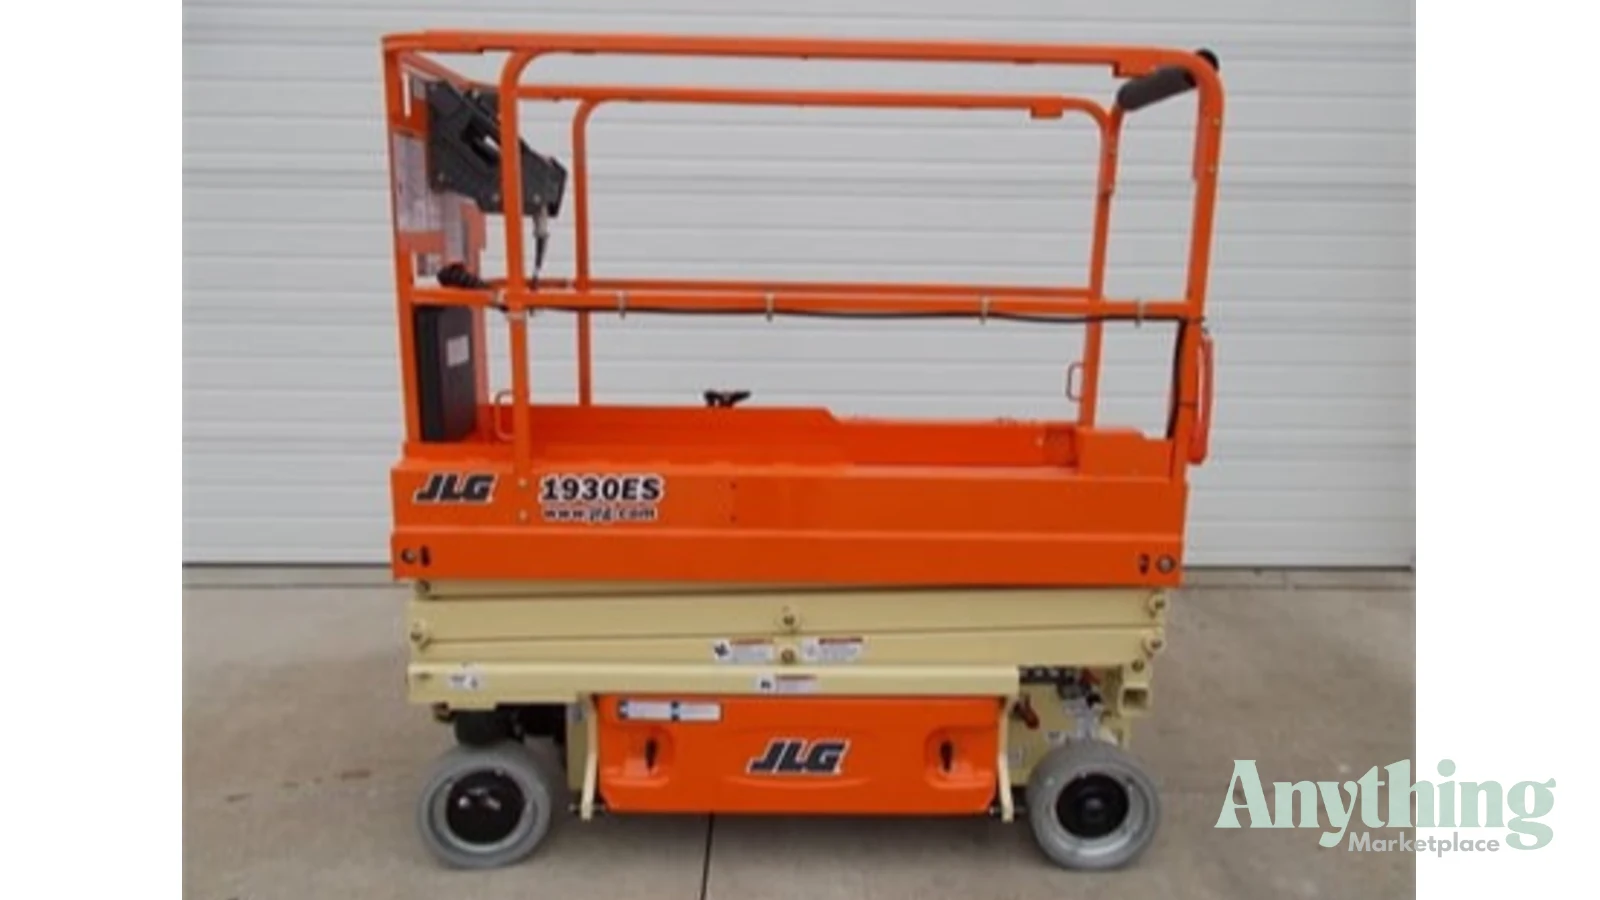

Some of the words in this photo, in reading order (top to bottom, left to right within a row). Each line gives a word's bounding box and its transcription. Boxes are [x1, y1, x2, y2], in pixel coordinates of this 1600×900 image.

[415, 474, 494, 502] JLG
[541, 477, 661, 501] 1930ES
[544, 506, 657, 522] www.jlg.com
[749, 740, 847, 774] JLG
